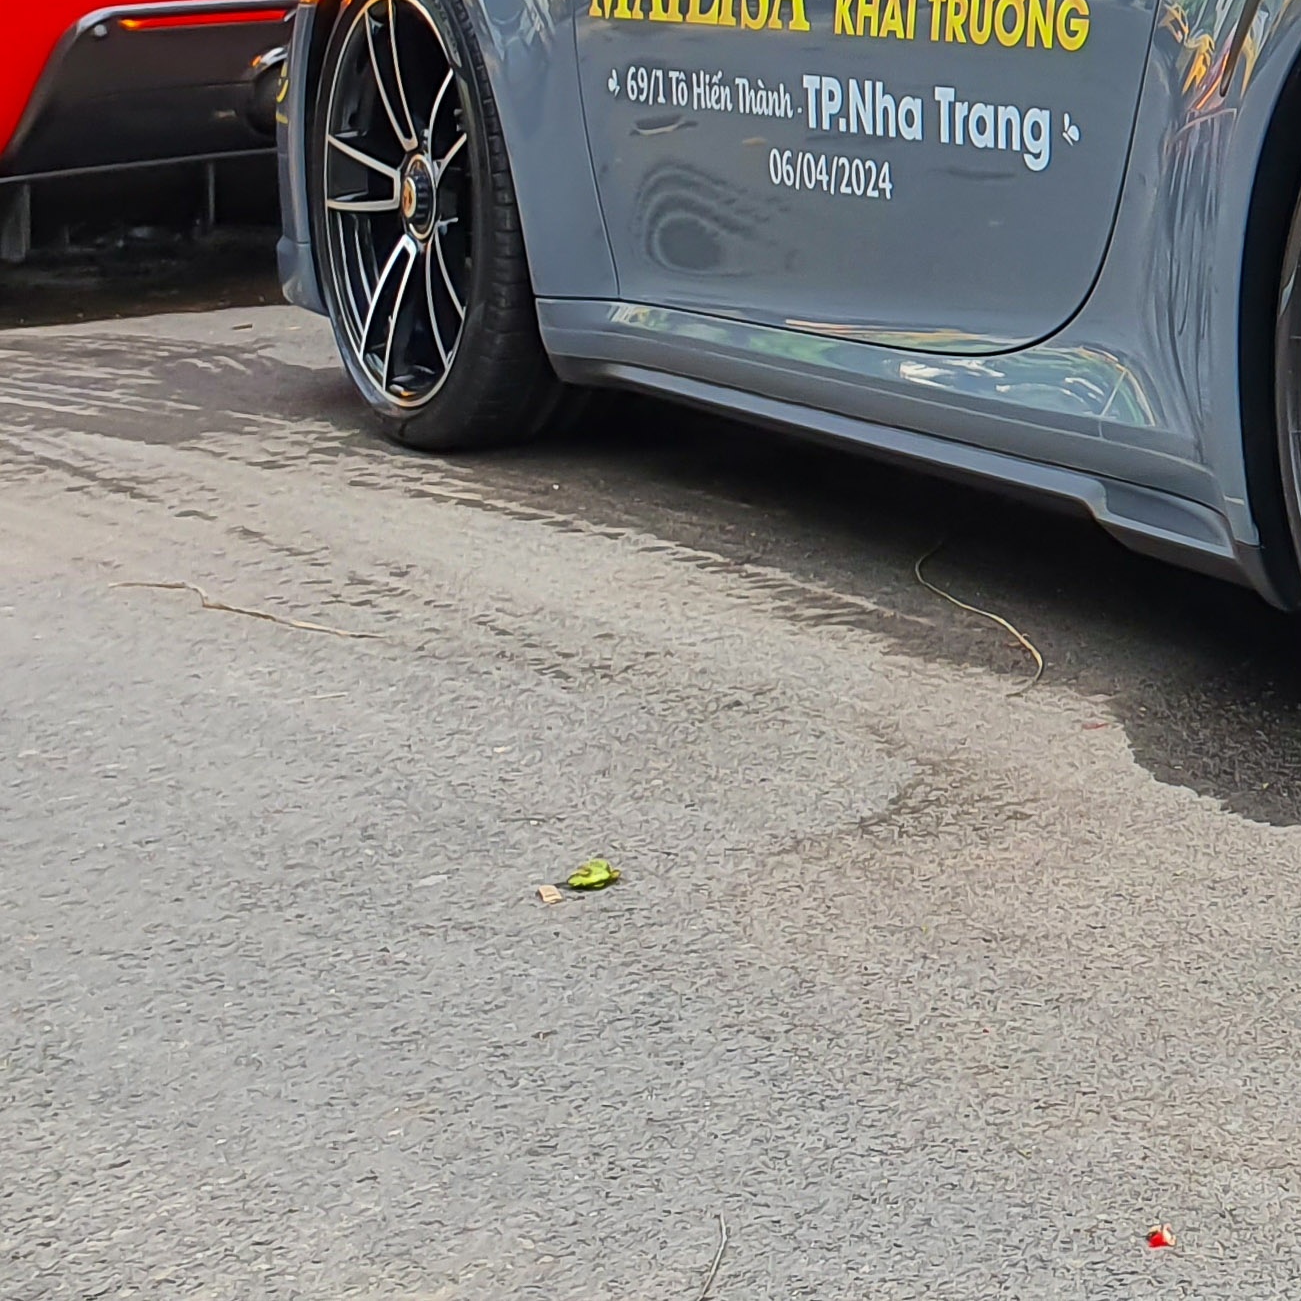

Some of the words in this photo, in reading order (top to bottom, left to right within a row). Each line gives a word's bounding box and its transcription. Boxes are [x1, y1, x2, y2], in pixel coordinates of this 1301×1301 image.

[626, 66, 666, 105] 69/1
[668, 70, 688, 107] Tô
[692, 70, 733, 111] Hiến
[734, 77, 794, 119] Thành
[803, 74, 923, 141] TP.Nha
[934, 86, 1051, 172] Trang
[769, 147, 893, 200] 06/04/2024
